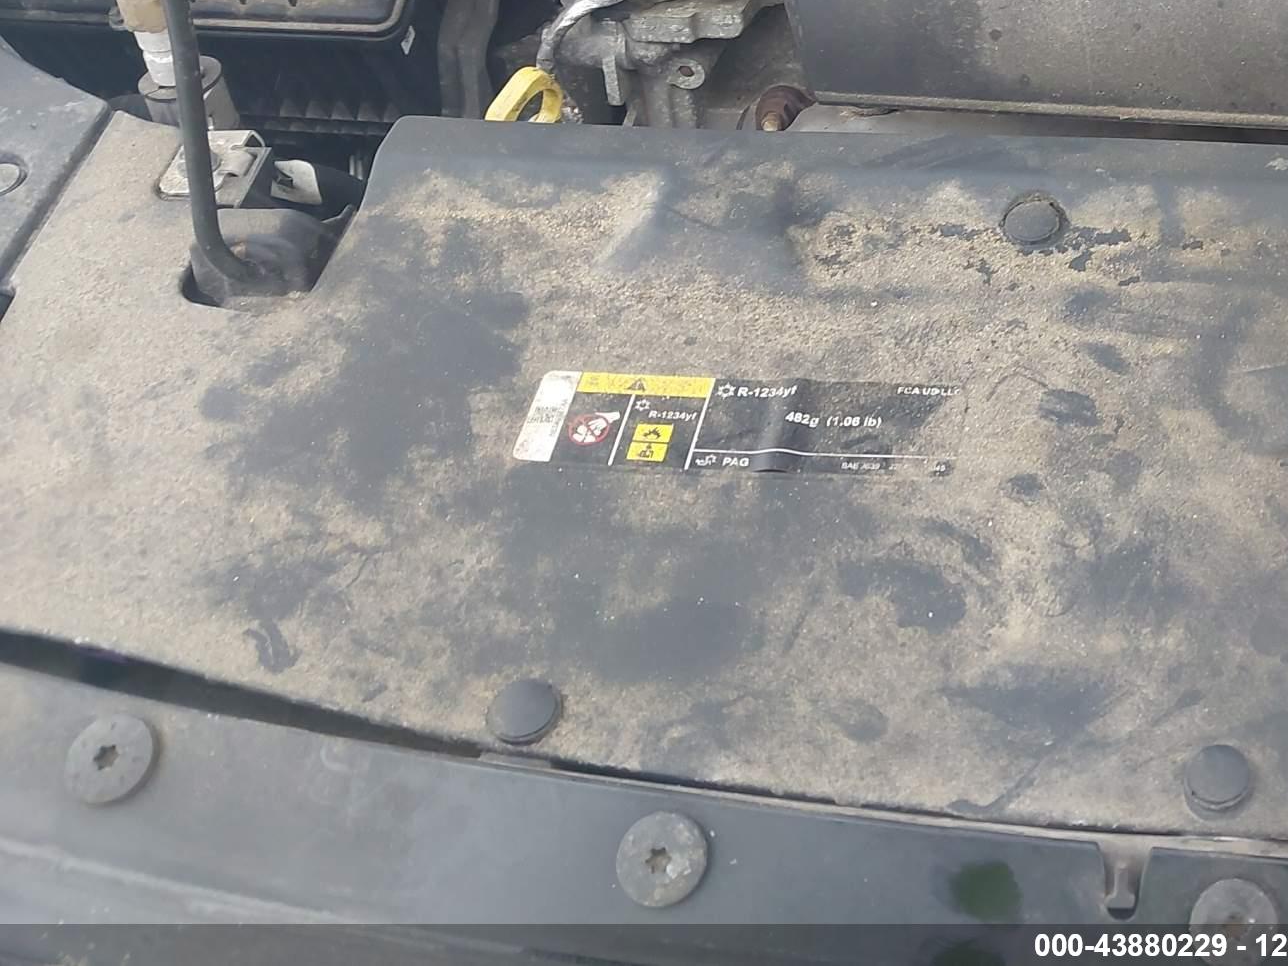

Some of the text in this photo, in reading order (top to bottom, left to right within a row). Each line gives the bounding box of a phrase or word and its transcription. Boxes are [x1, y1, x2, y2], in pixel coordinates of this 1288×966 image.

[736, 384, 798, 399] R-1234yf
[648, 409, 698, 424] R-1234yf
[784, 411, 820, 427] 482g
[863, 416, 883, 429] lb)
[722, 457, 750, 467] PAG
